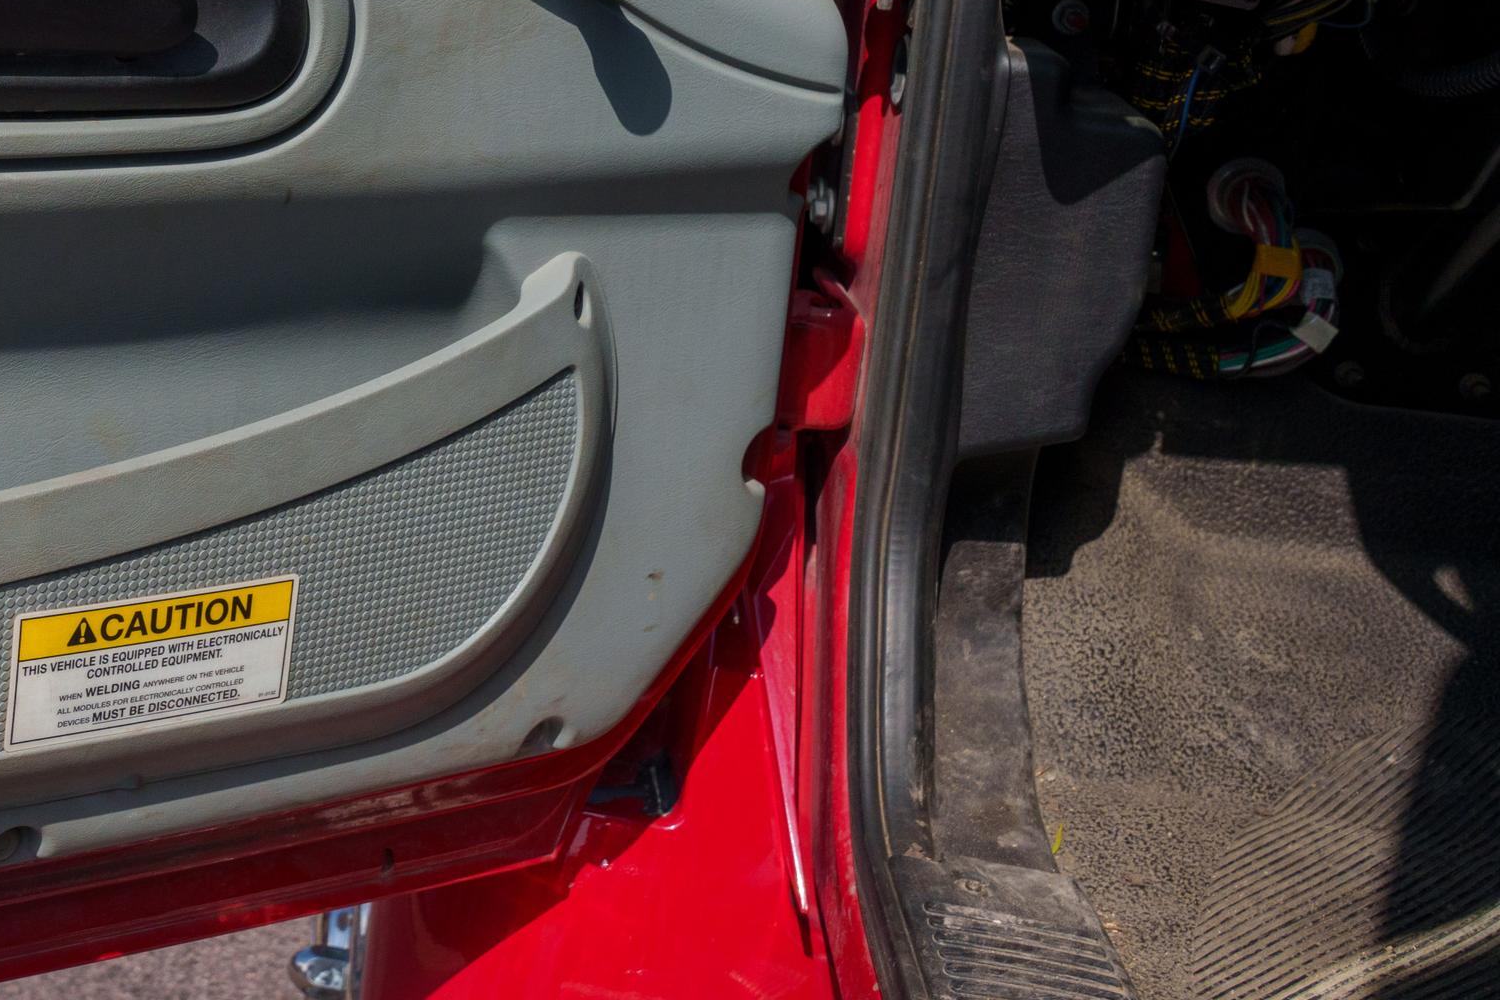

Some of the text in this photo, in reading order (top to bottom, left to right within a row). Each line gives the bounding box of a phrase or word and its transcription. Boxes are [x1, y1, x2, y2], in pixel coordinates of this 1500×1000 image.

[100, 594, 253, 642] CAUTION
[23, 625, 284, 677] THIS VEHICLE IS EQUIPPED WITH ELECTRONICALLY
[87, 649, 223, 679] CONTROLLED EQUIPMENT.
[59, 692, 83, 702] WHEN
[86, 680, 140, 698] WELDING
[143, 676, 184, 688] ANYWHERE
[199, 671, 214, 679] THE
[215, 665, 245, 676] VEHICLE
[73, 700, 111, 713] MODULES
[112, 697, 129, 705] FOR
[130, 686, 194, 703] ELECTRONICALLY
[195, 678, 244, 691] CONTROLLED
[57, 688, 241, 728] DEVICES MUST BE DISCONNECTED.
